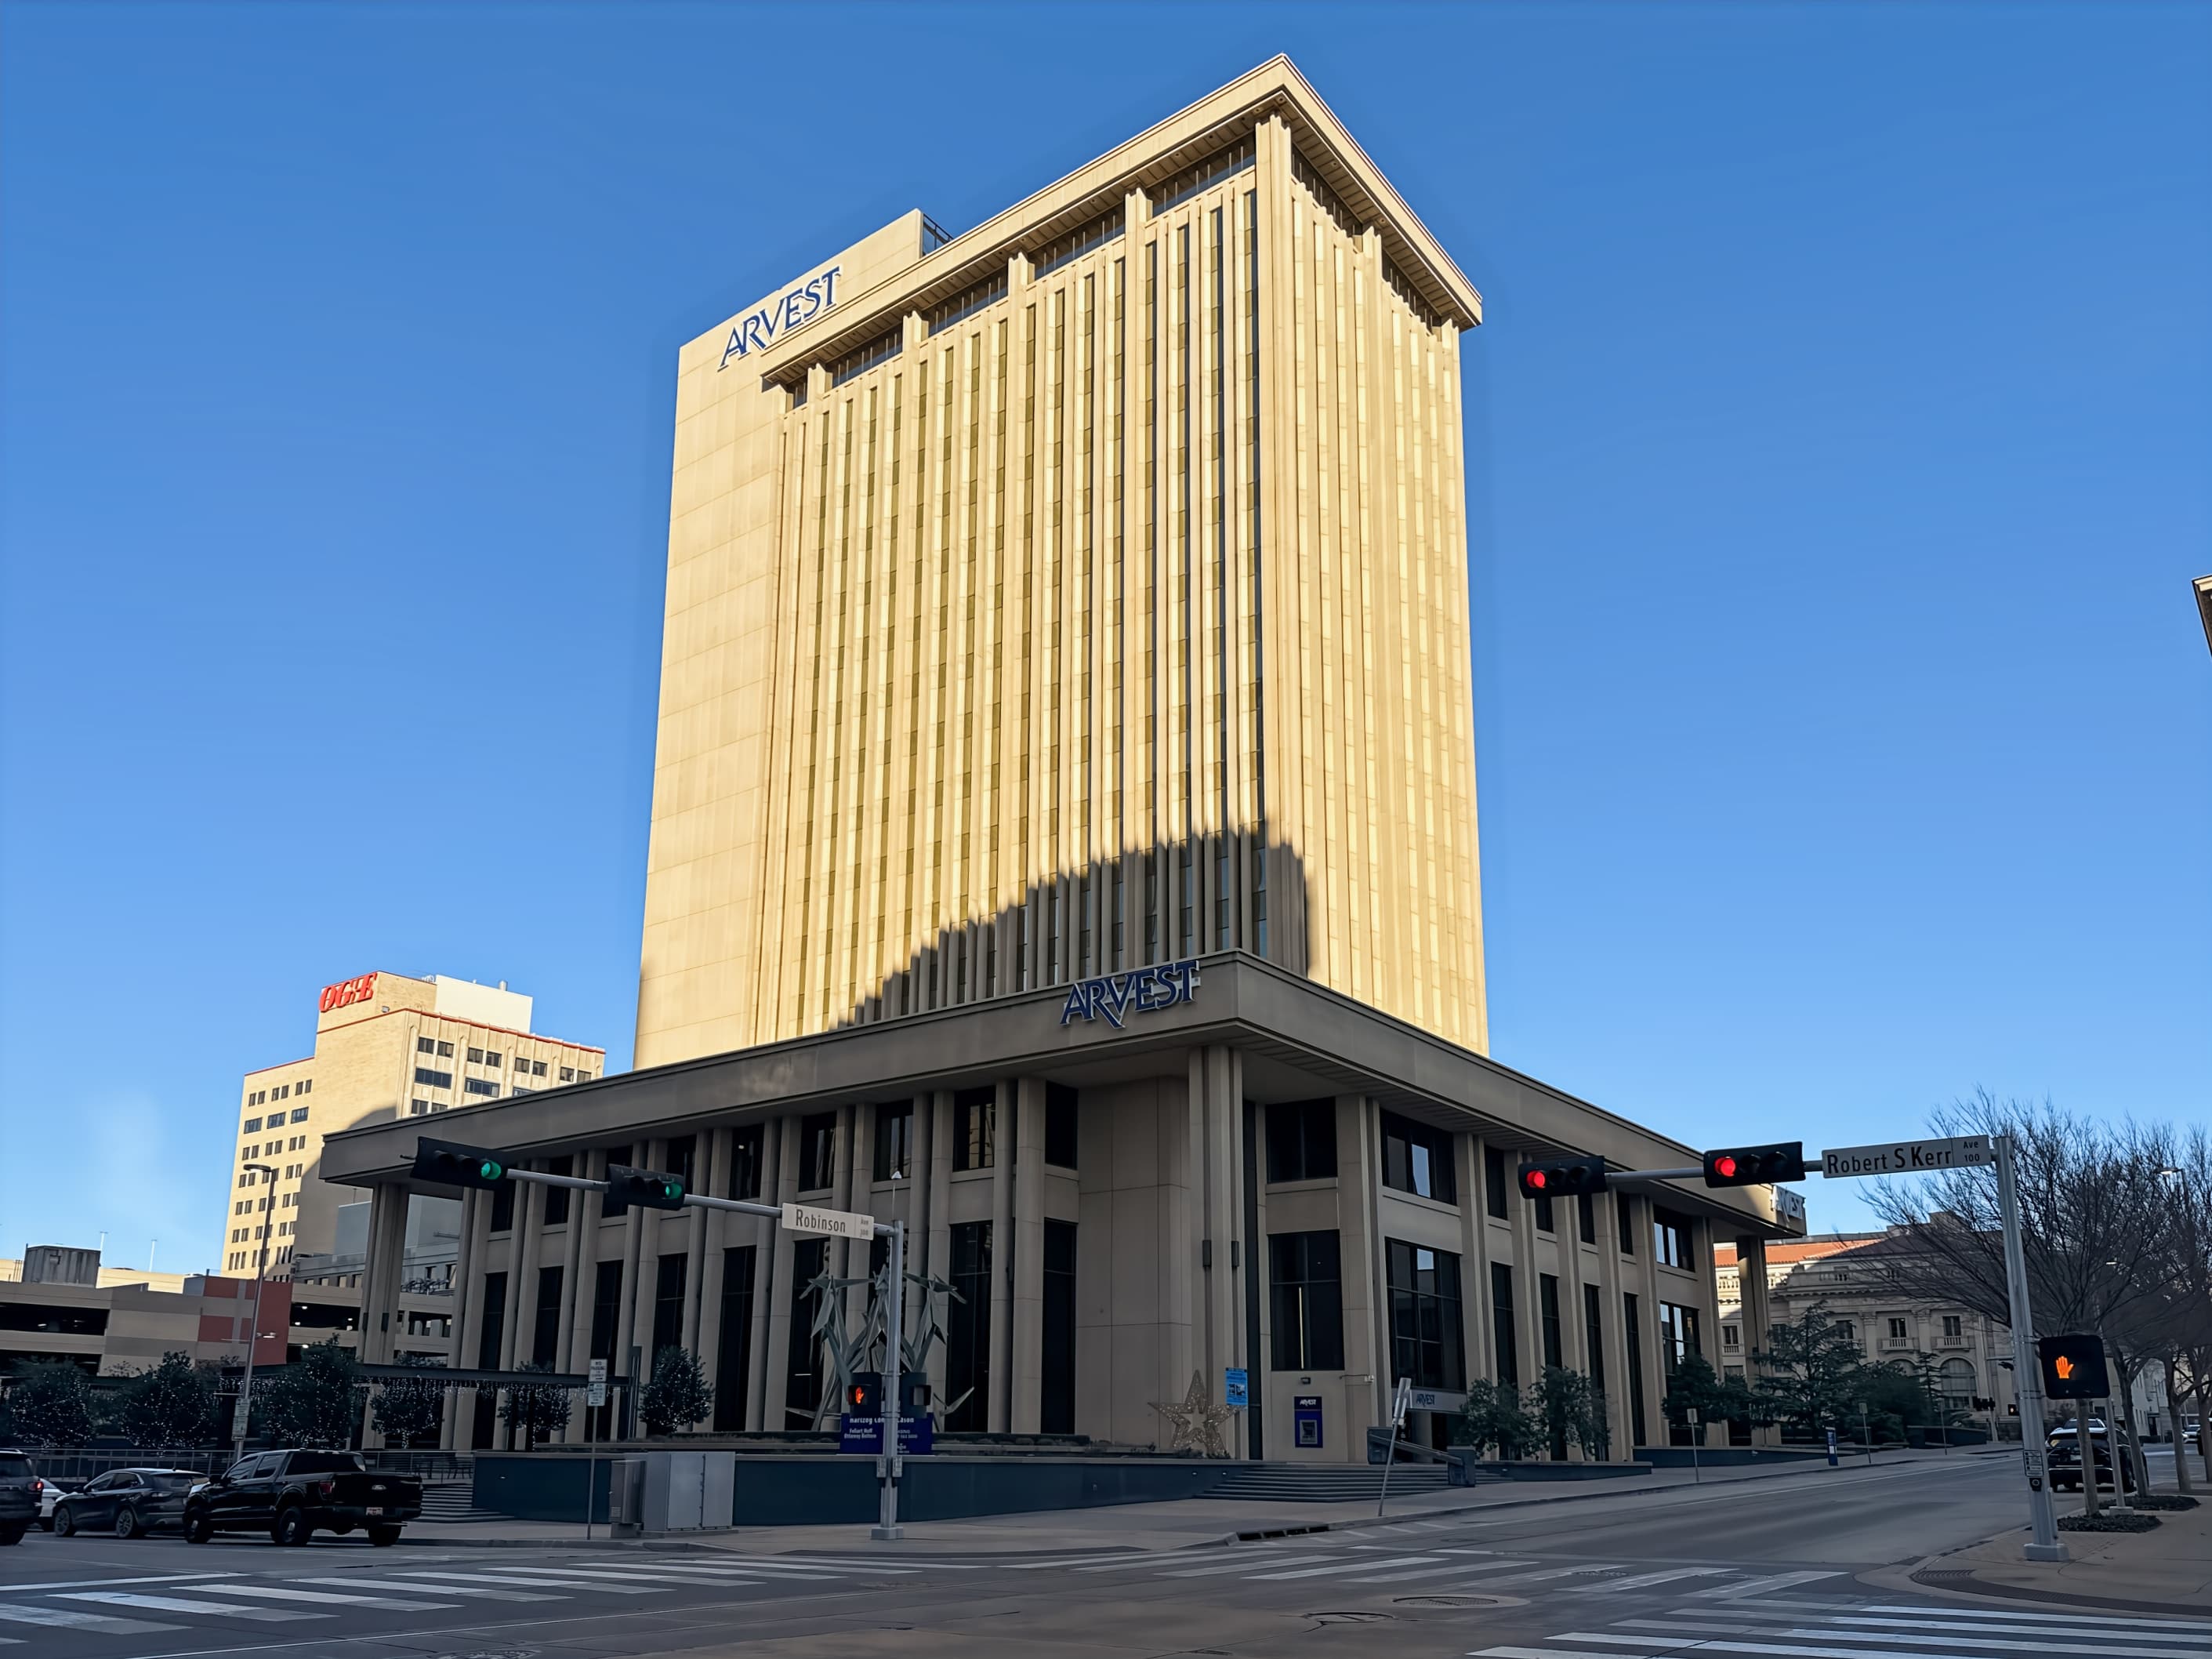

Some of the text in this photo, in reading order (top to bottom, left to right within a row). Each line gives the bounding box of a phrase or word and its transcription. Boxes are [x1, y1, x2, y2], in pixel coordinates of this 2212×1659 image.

[720, 266, 839, 367] ARVEST
[1060, 960, 1200, 1029] ARVEST
[1963, 1141, 1979, 1149] Ave
[1964, 1153, 1980, 1163] 100
[1826, 1145, 1952, 1174] Robert S Kerr
[796, 1208, 846, 1233] Robinson
